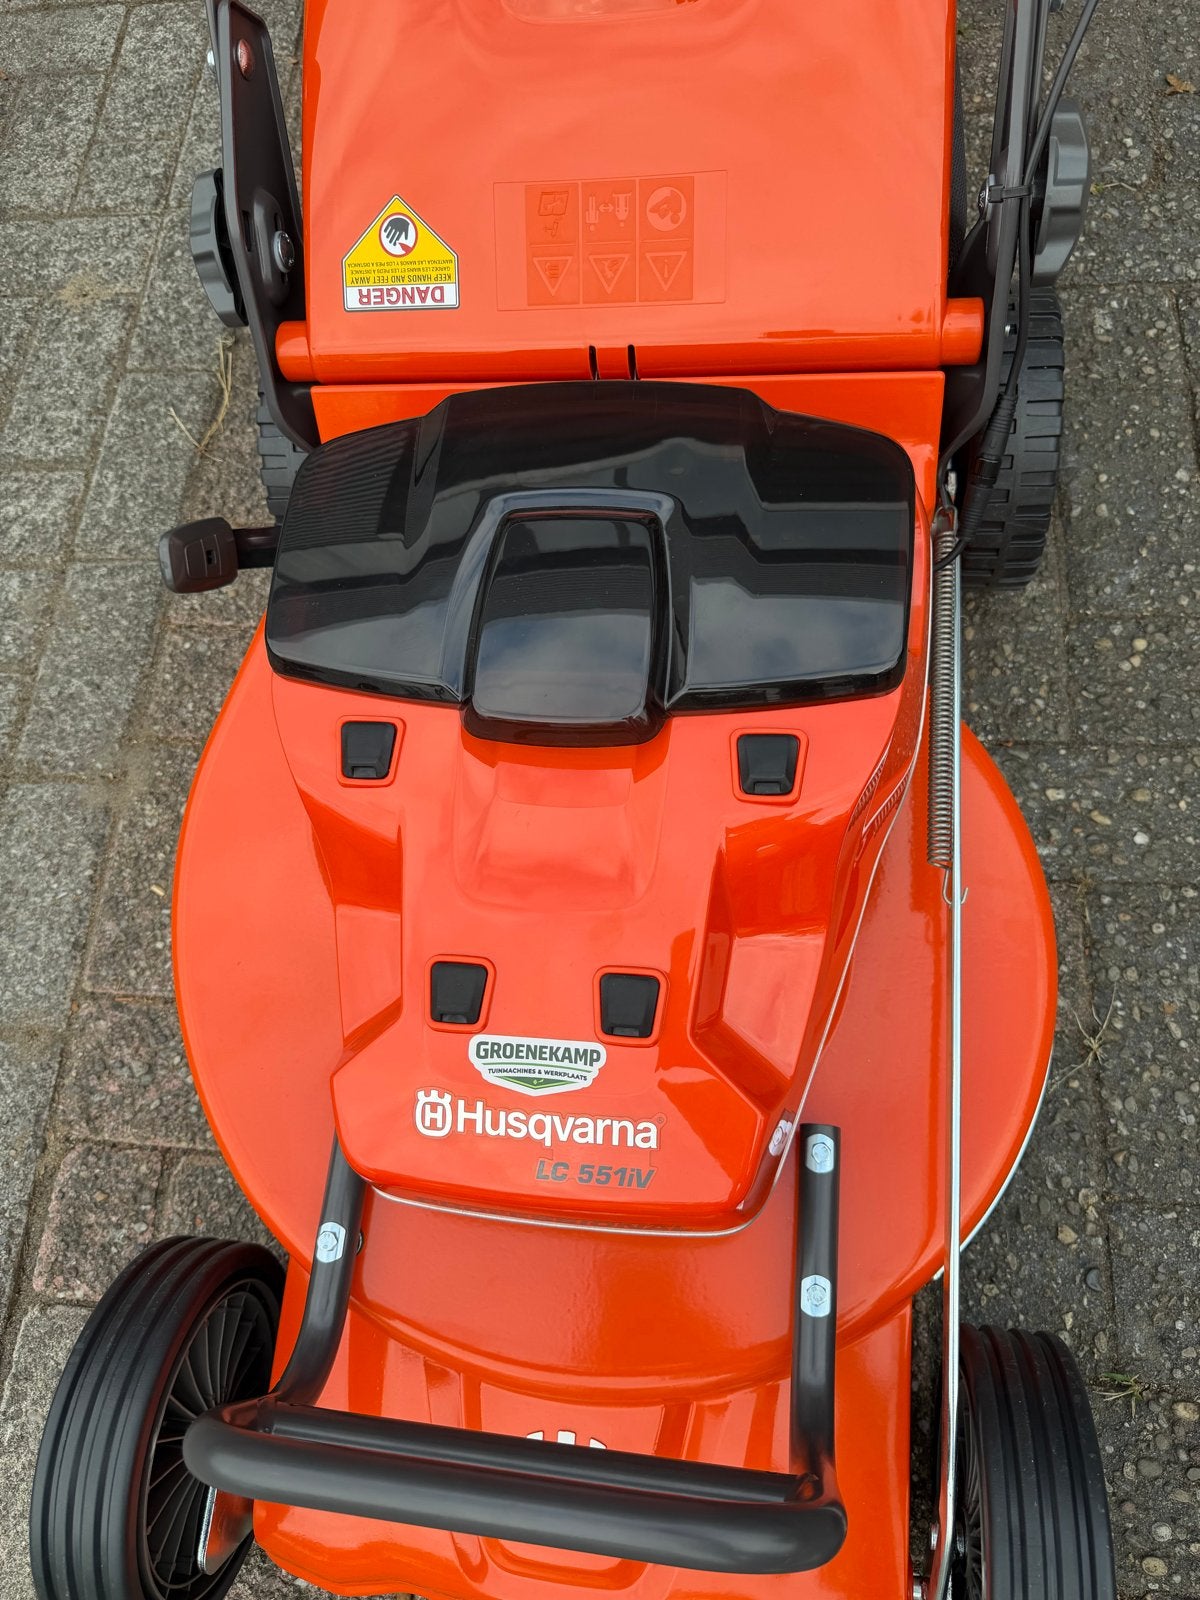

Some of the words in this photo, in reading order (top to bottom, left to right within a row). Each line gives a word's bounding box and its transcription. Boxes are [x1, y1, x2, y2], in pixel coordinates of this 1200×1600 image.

[350, 276, 371, 285] AWAY
[373, 275, 389, 284] FEET
[391, 274, 405, 283] AND
[407, 274, 432, 283] HANDS
[434, 273, 452, 282] KEEP
[358, 285, 445, 305] DANGER
[475, 1040, 601, 1067] GROENEKAMP
[488, 1068, 536, 1076] TUINMACHINES
[543, 1069, 588, 1081] WERKPLAATS
[457, 1099, 658, 1149] Husqvarna
[536, 1160, 569, 1181] LC
[577, 1164, 656, 1189] 551iV
